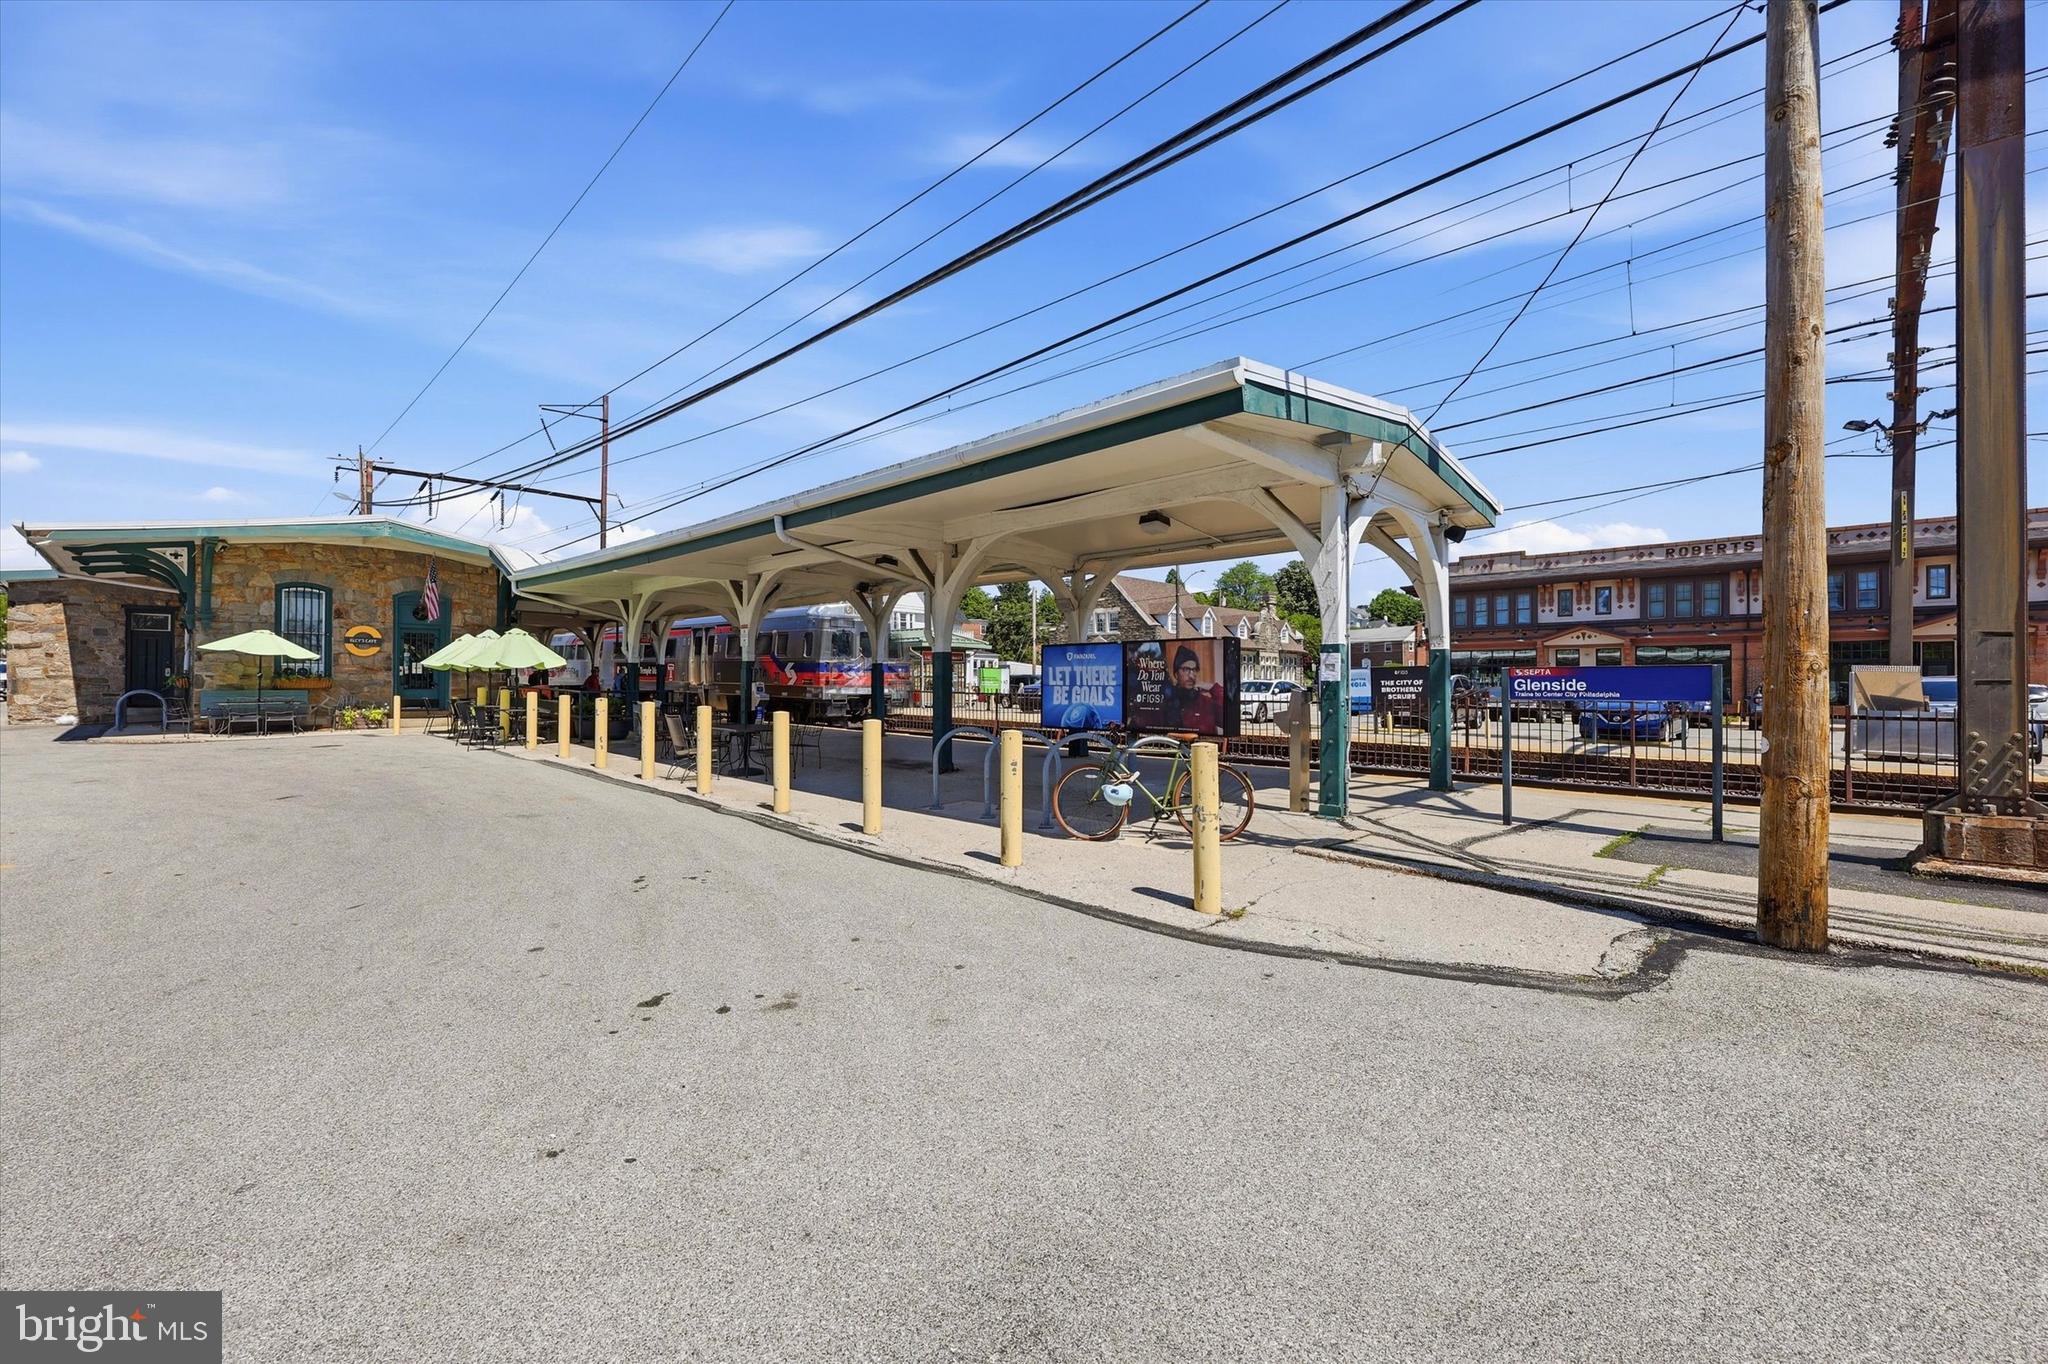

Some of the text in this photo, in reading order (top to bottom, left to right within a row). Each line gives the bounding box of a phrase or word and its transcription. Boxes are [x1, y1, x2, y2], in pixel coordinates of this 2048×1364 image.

[1665, 541, 1755, 558] ROBERTS
[1138, 656, 1165, 669] Where
[1048, 665, 1117, 686] LET THERE
[1137, 670, 1165, 681] Do You
[1141, 681, 1162, 692] Wear
[1514, 679, 1587, 692] Glenside
[1053, 686, 1115, 706] BE GOALS
[1142, 694, 1165, 703] FIGS?
